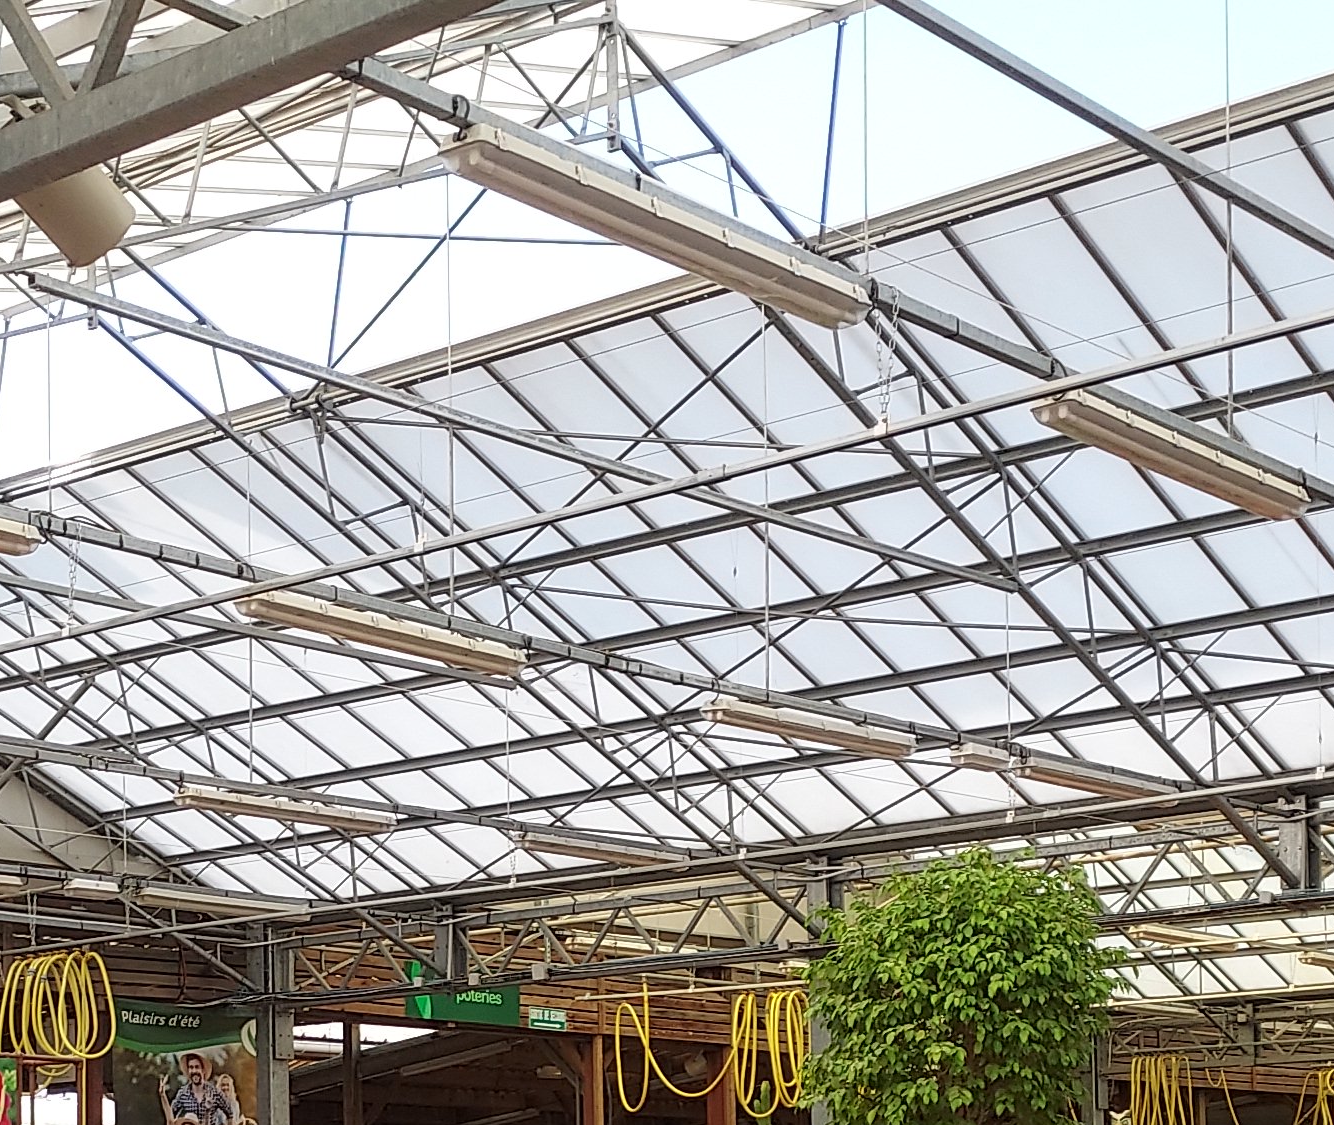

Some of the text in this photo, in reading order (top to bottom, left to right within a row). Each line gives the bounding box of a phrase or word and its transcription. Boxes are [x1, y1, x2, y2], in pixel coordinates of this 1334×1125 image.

[456, 990, 503, 1004] poteries
[121, 1010, 201, 1028] Plaisirs d'été
